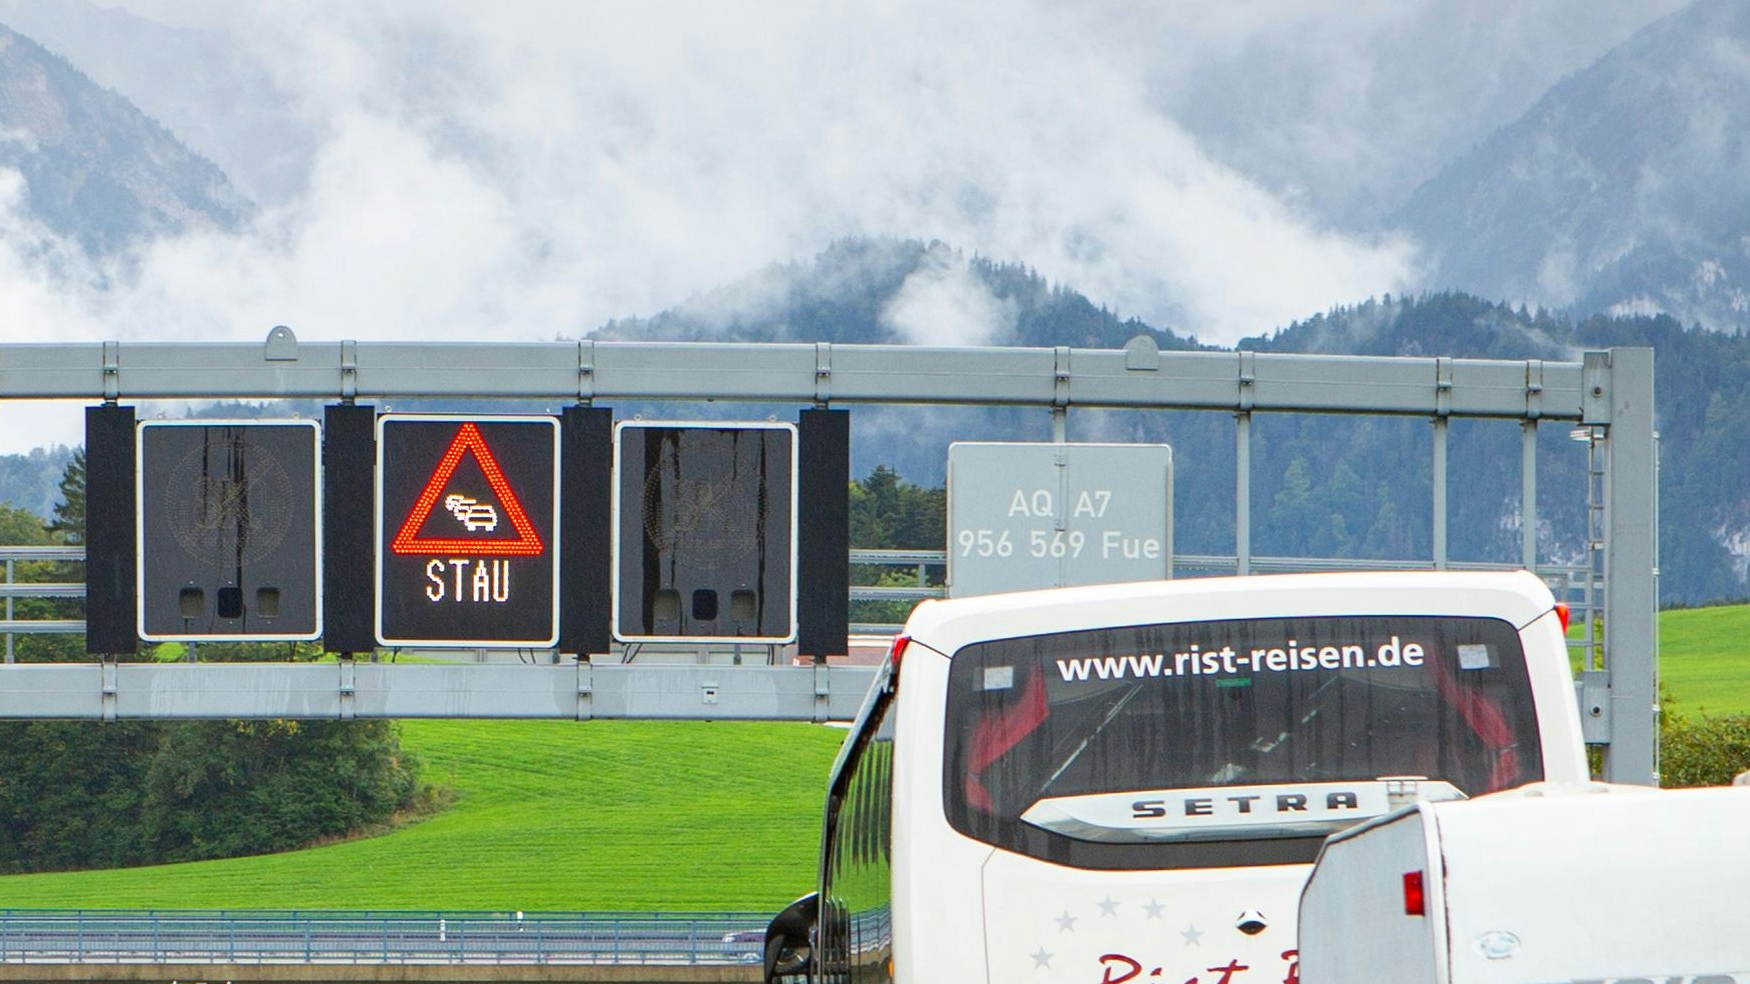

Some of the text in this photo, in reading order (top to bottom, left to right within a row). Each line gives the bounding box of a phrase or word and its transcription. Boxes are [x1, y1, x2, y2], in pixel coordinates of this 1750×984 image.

[1008, 489, 1112, 518] AQ A7
[958, 530, 1160, 559] 956 569 Fue
[426, 559, 509, 602] STAU
[1056, 636, 1424, 682] www.rist-reisen.de
[1131, 791, 1358, 819] SETRA
